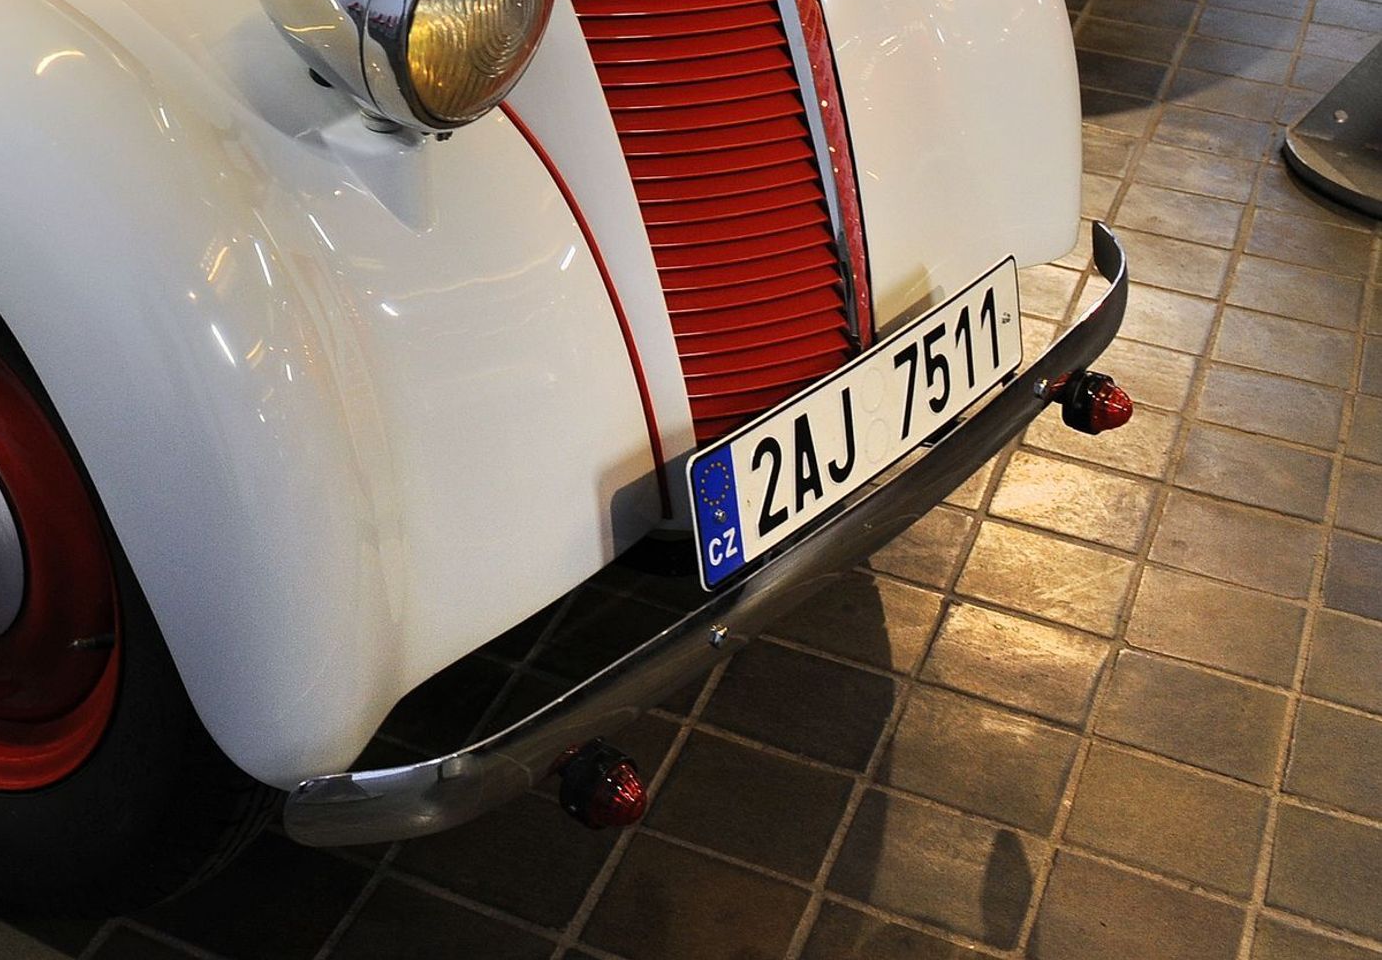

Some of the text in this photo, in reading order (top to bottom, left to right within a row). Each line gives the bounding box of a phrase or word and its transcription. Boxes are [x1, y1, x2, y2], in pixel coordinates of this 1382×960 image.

[751, 286, 1000, 538] 2AJ 7511
[708, 527, 739, 567] CZ
